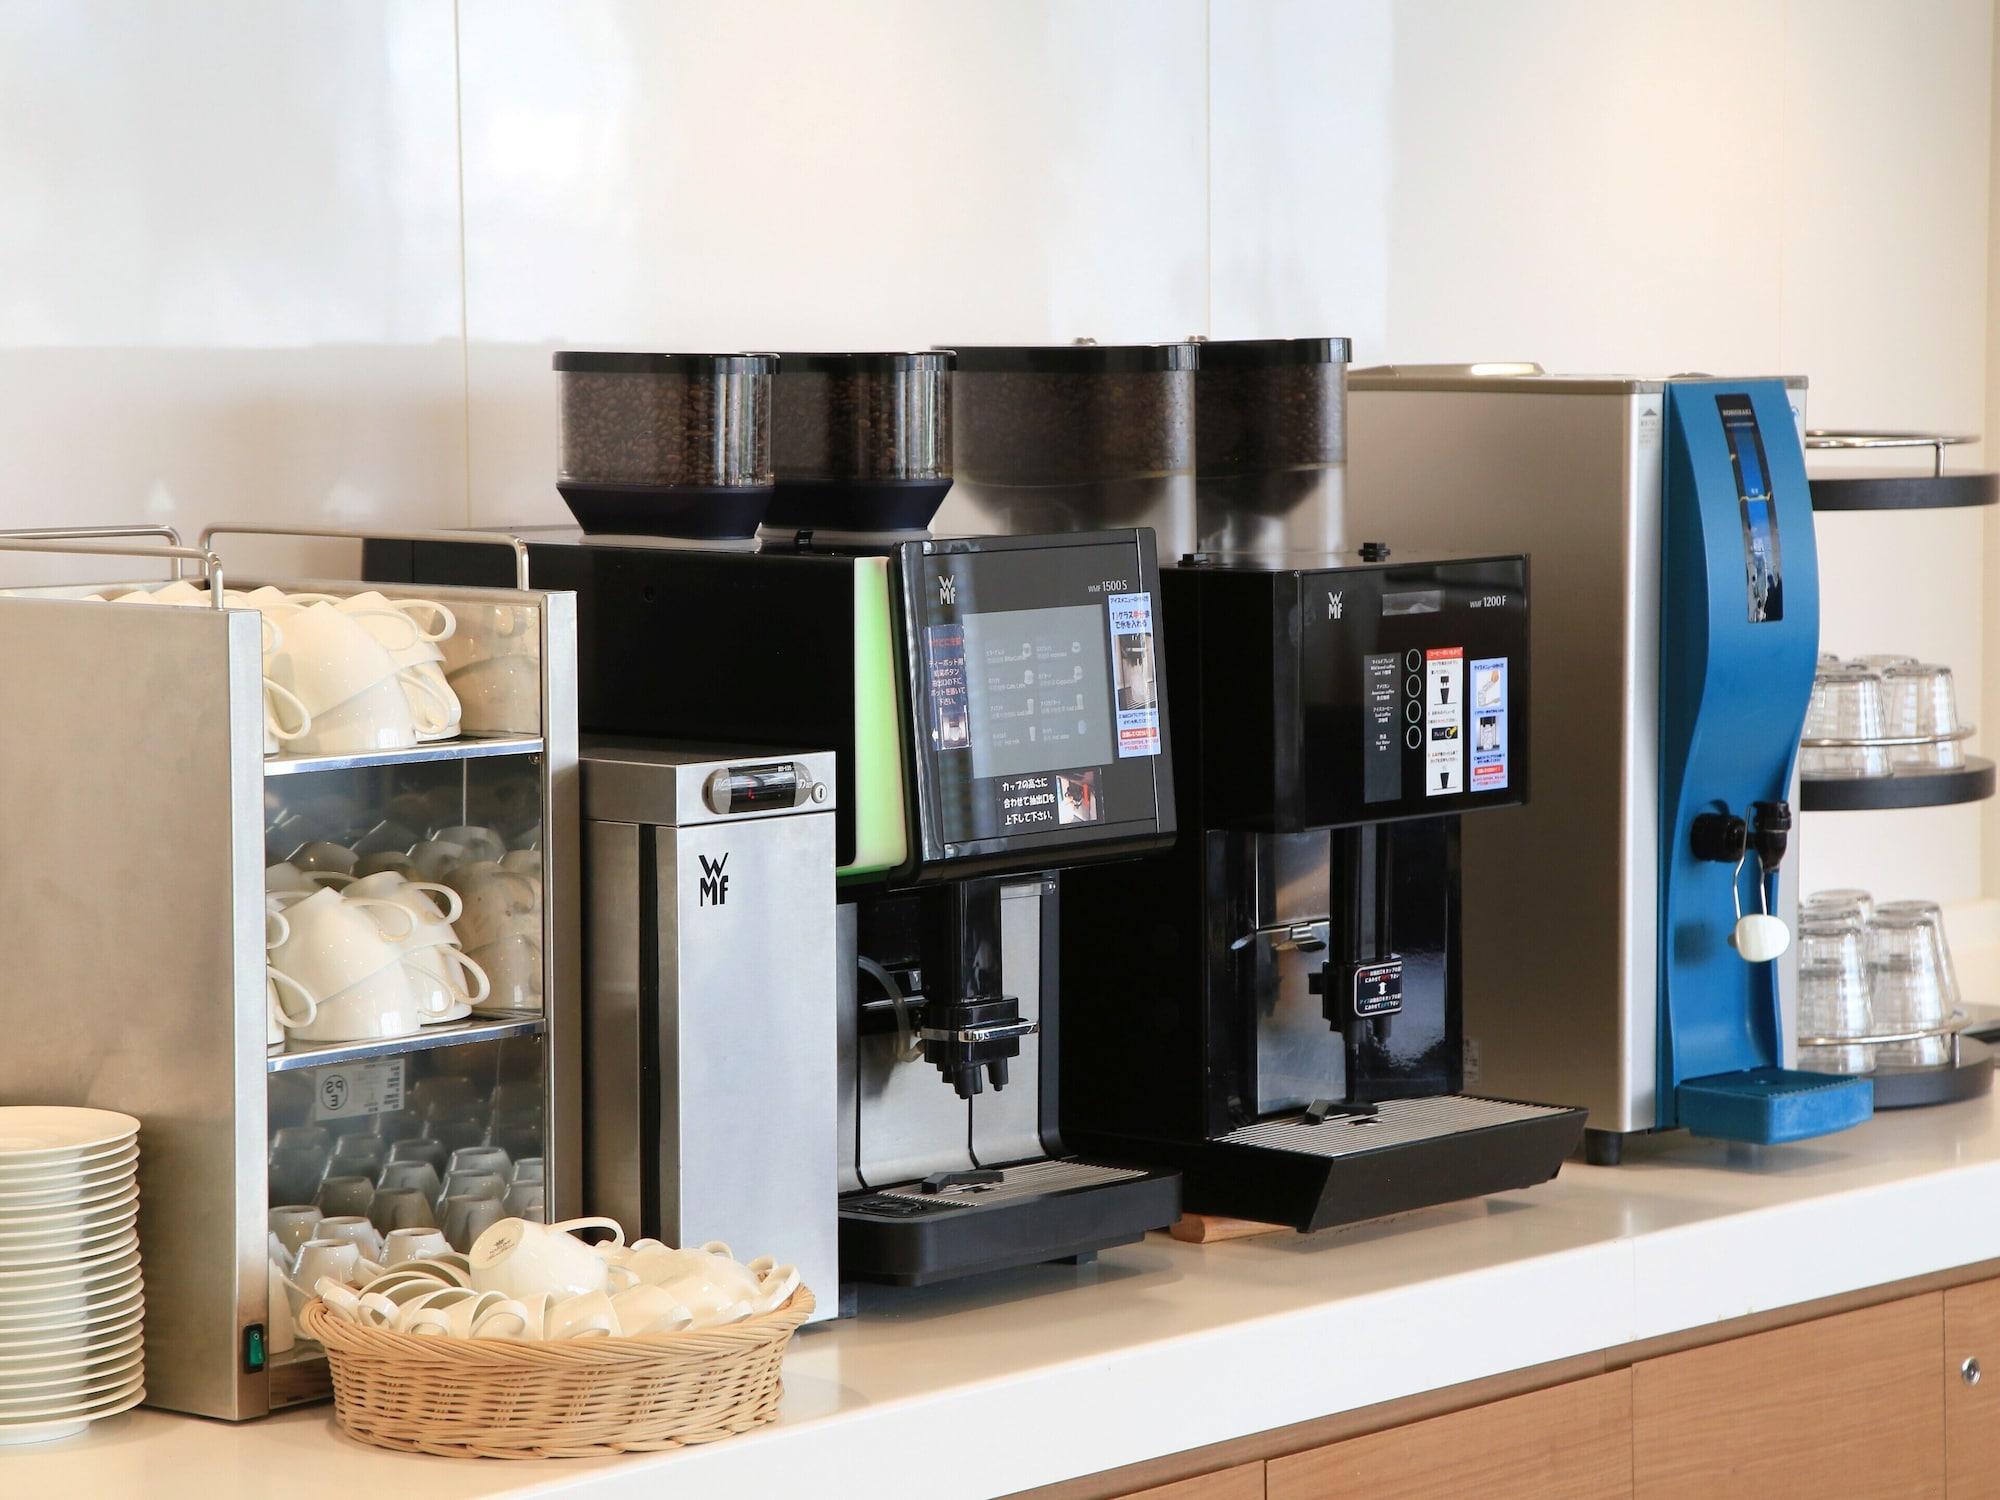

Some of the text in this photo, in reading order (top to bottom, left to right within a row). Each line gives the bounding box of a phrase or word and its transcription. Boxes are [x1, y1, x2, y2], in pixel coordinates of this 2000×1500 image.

[1102, 580, 1122, 592] 1500
[1483, 595, 1501, 608] 1200
[1002, 777, 1048, 792] カップの高さに
[1003, 793, 1056, 809] 合わせて抽出口を
